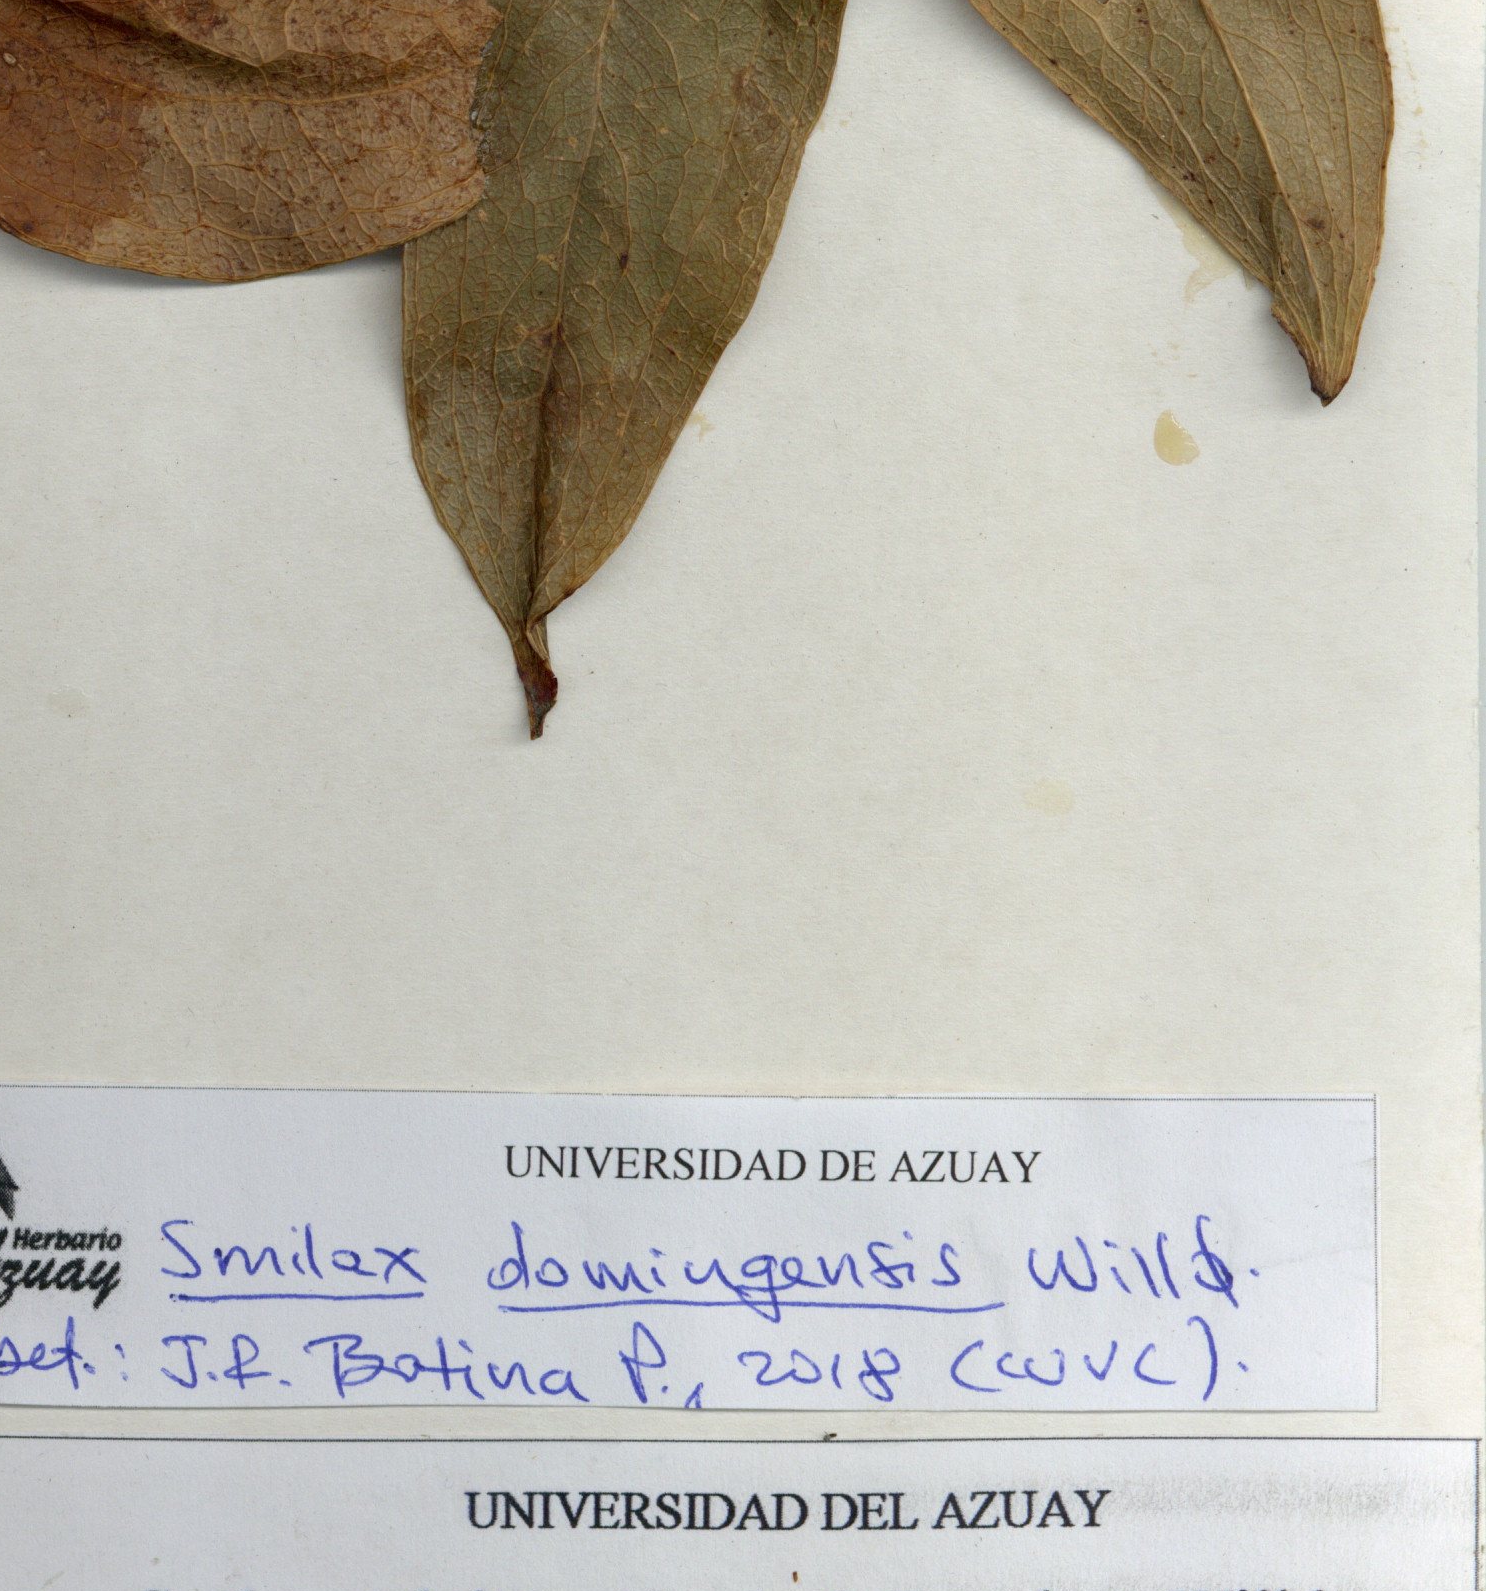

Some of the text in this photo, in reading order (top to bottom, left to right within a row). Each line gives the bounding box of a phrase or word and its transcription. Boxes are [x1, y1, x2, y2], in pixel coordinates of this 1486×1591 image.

[504, 1145, 1042, 1184] UNIVERSIDAD DE AZUAY
[11, 1227, 122, 1253] Herbario
[160, 1219, 427, 1281] Smilax
[737, 1349, 902, 1402] 2018
[463, 1489, 1112, 1532] UNIVERSIDAD DEL AZUAY
